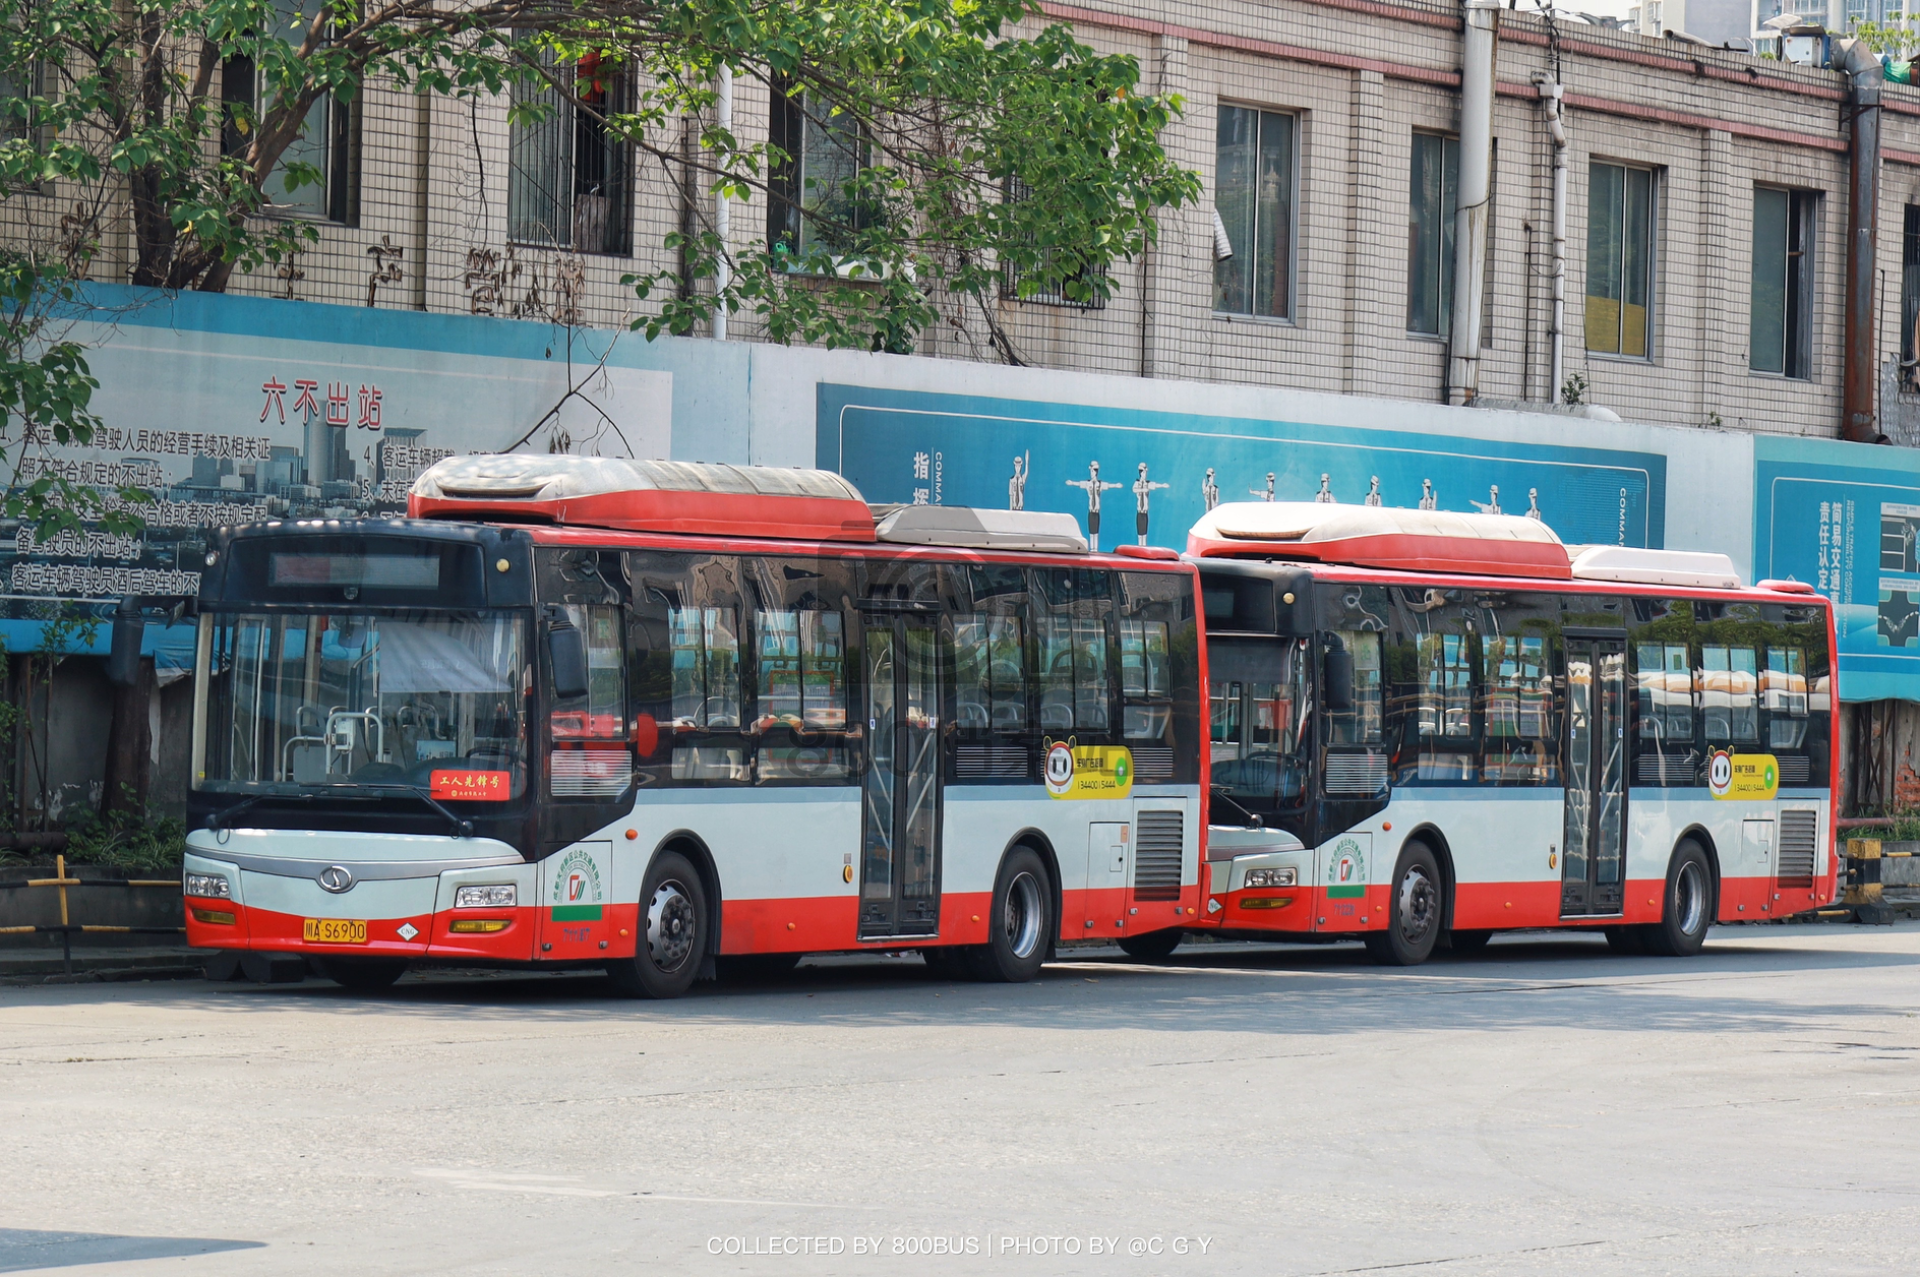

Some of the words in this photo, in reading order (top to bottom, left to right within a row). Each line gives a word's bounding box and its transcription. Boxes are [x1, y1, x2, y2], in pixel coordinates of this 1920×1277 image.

[259, 374, 382, 431] 六不出站
[361, 478, 415, 503] 5、未在
[935, 451, 943, 506] COMMA
[1818, 501, 1830, 590] 责任认定
[400, 927, 415, 935] CNG
